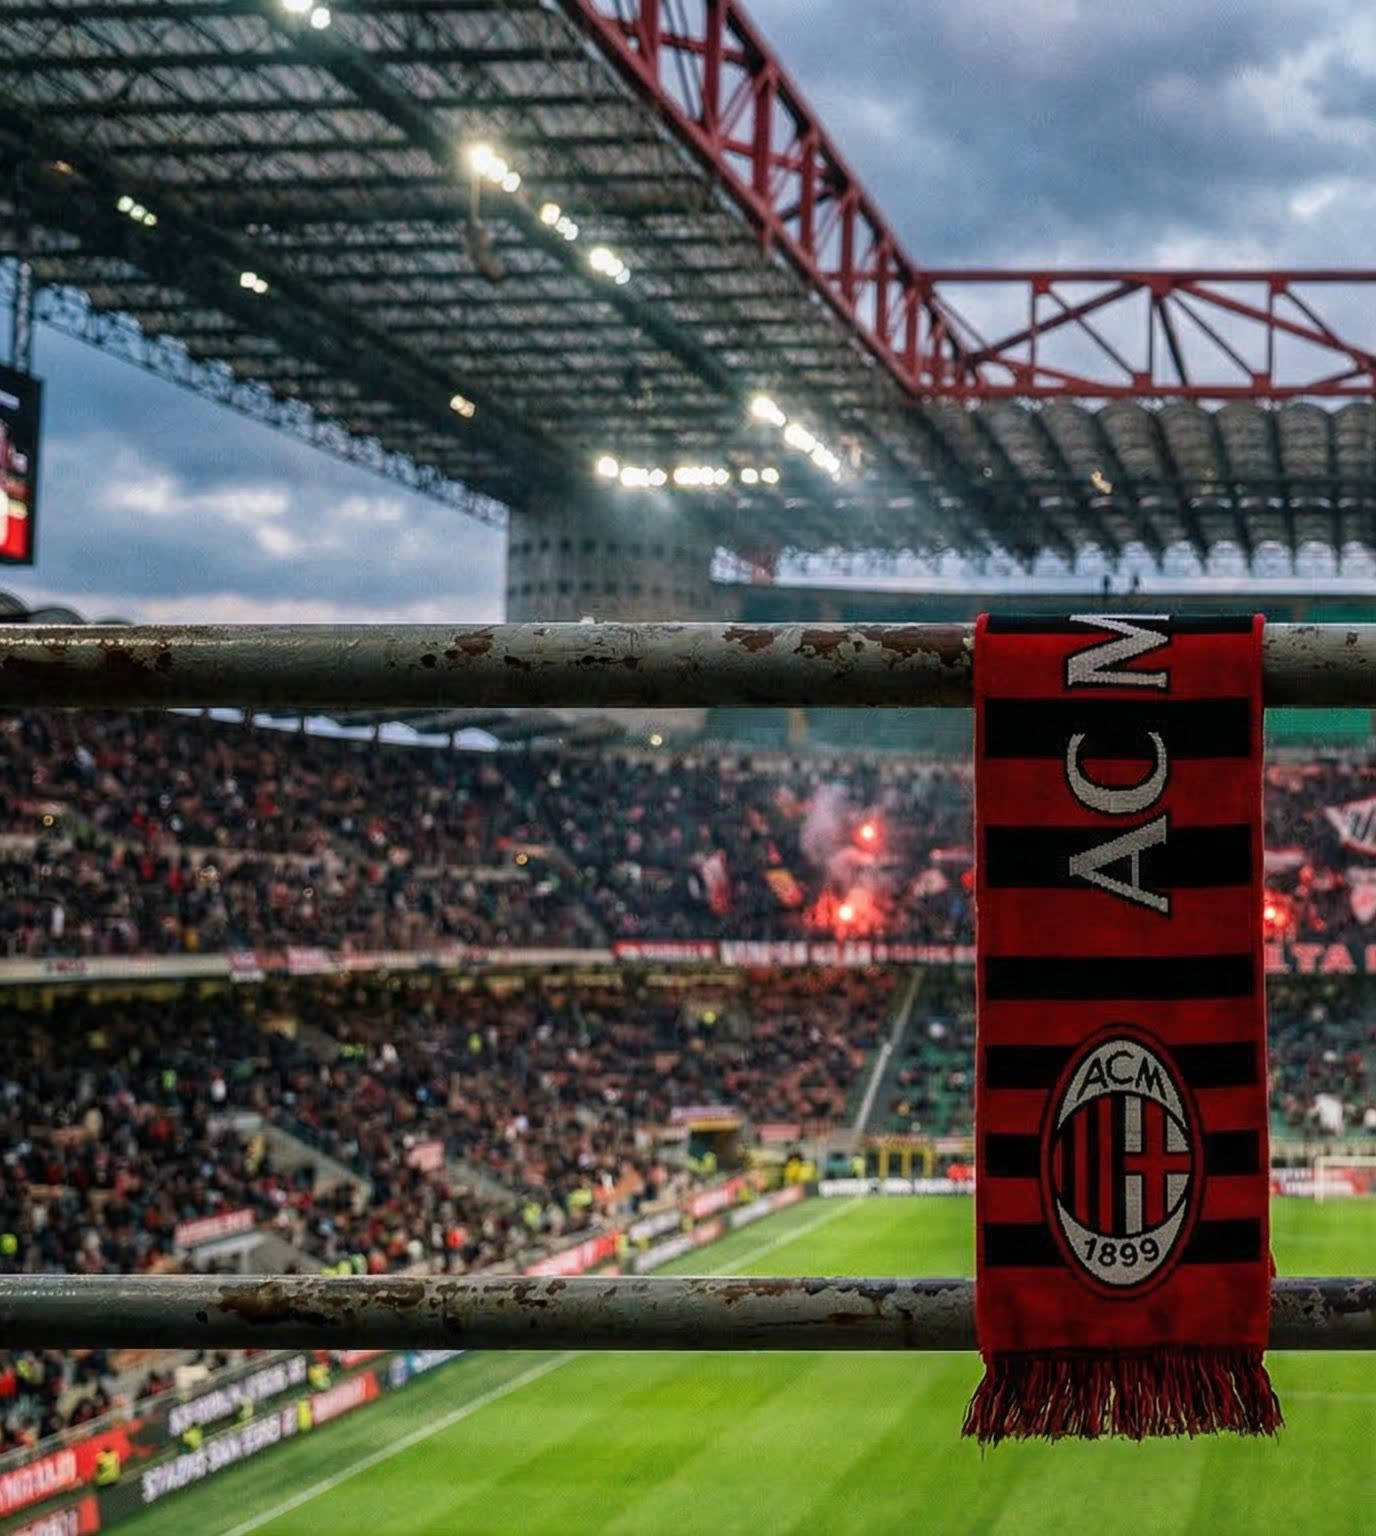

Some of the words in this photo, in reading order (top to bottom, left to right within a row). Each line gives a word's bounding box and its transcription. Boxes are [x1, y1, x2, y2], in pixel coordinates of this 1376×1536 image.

[1067, 732, 1168, 913] AC
[1077, 1051, 1167, 1101] ACM
[1084, 1238, 1160, 1267] 1899
